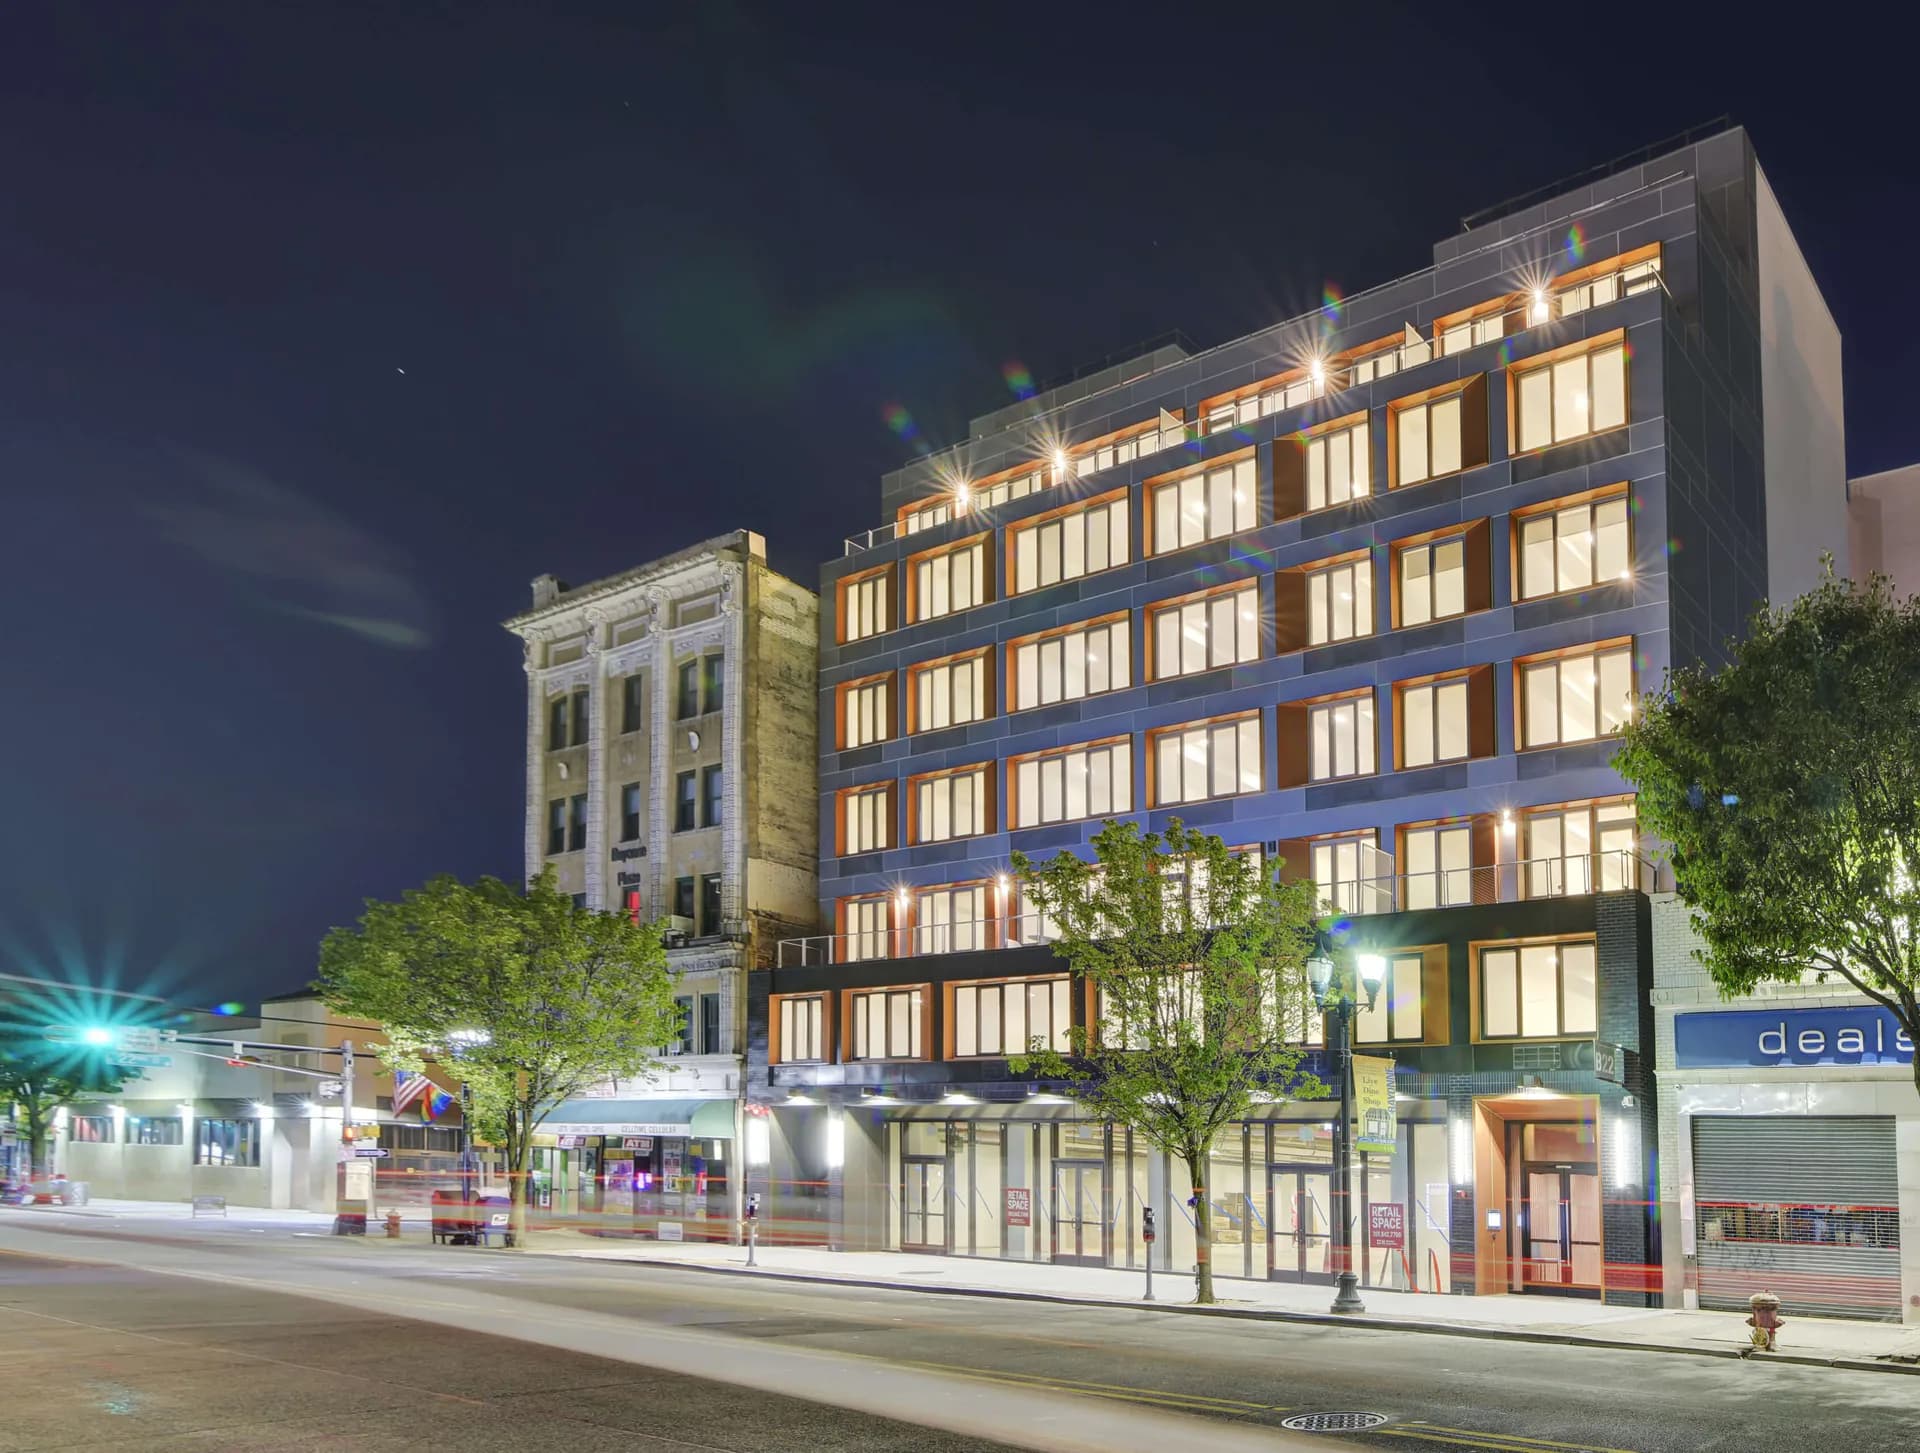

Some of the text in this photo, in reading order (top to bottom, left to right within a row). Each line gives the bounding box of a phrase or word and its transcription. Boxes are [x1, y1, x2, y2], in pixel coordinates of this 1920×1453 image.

[1758, 1018, 1916, 1054] deals
[1595, 1052, 1614, 1075] B22
[1362, 1076, 1378, 1084] Live
[1362, 1086, 1379, 1095] Dine
[1362, 1096, 1382, 1106] Shop
[1008, 1190, 1029, 1200] RETAIL
[1008, 1200, 1029, 1210] SPACE
[1371, 1206, 1401, 1217] RETAIL
[1372, 1217, 1401, 1229] SPACE
